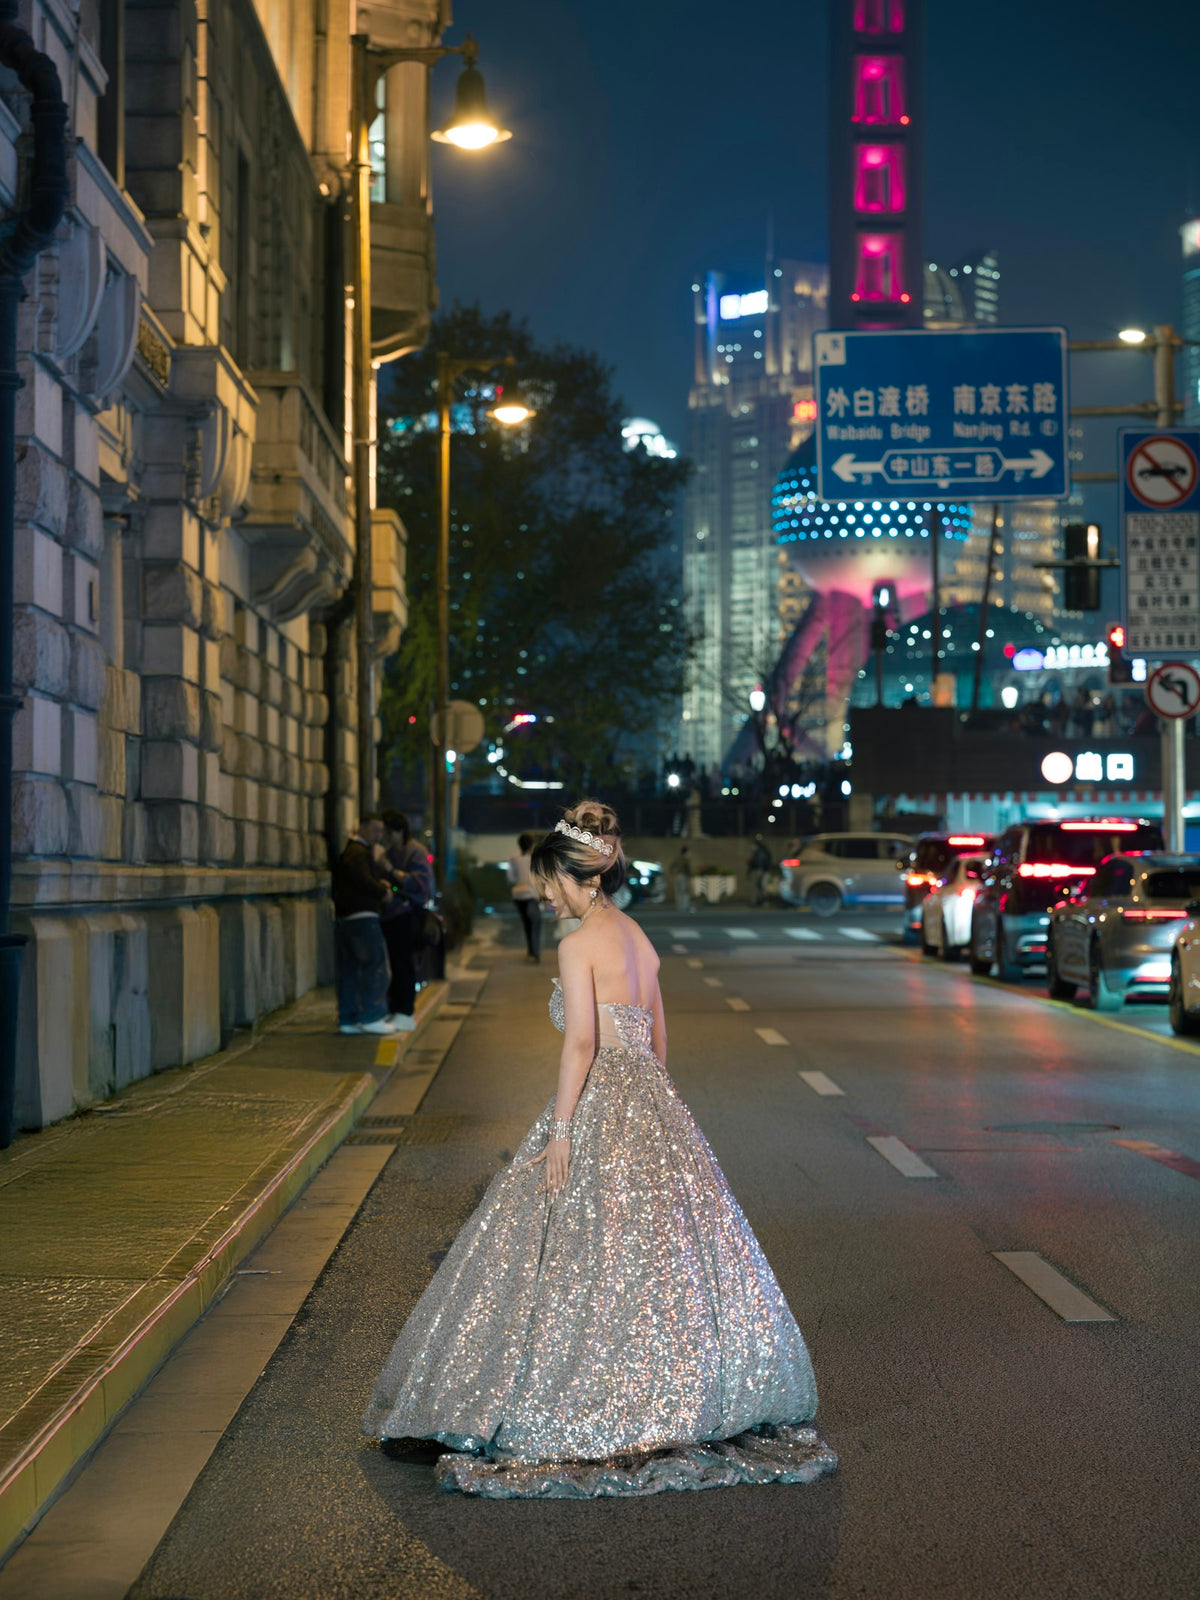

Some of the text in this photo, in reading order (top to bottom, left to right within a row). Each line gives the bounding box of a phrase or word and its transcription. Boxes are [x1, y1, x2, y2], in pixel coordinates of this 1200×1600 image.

[826, 385, 929, 418] 外白渡桥
[953, 383, 1057, 415] 南京东路
[891, 423, 931, 442] Bridge
[953, 421, 1003, 441] Nanjing
[890, 455, 994, 477] 中山东一路
